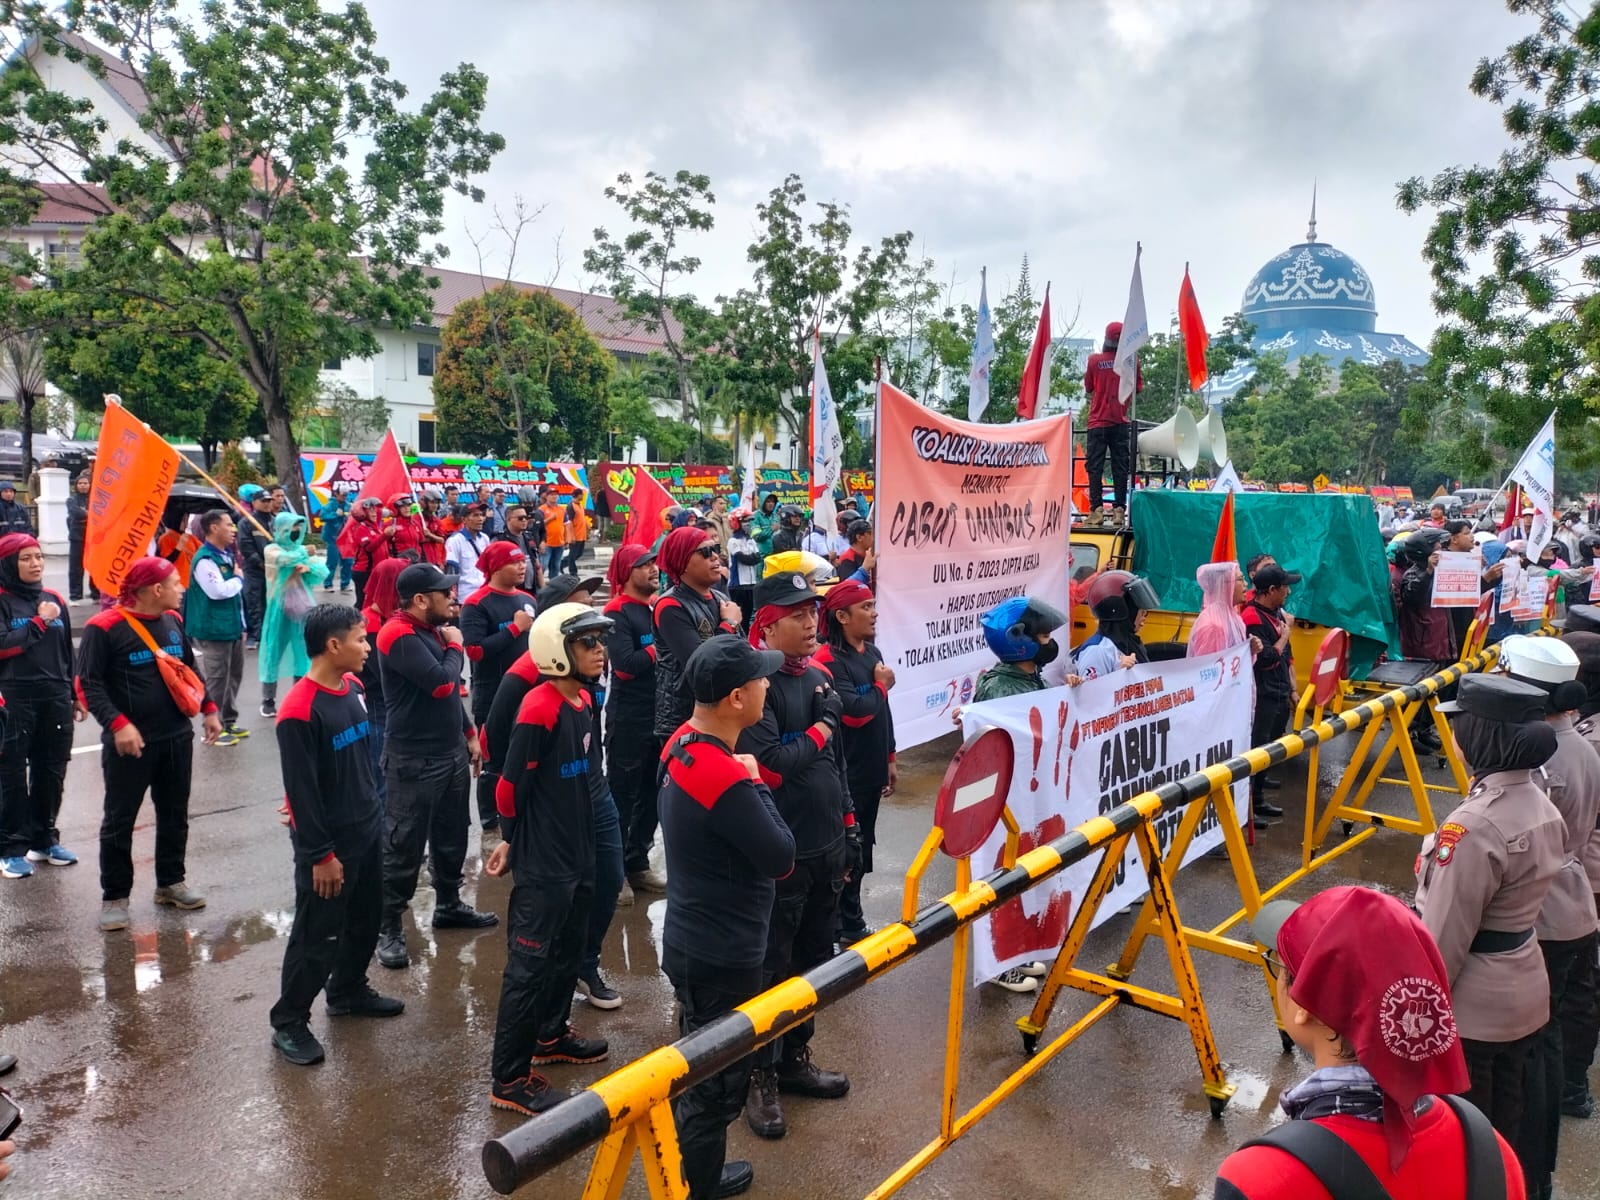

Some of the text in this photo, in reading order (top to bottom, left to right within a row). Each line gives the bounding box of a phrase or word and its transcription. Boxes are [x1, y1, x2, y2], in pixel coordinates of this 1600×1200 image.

[911, 426, 975, 464] KOALISI
[973, 439, 1021, 468] RAKYAT
[462, 465, 540, 484] Sukses
[961, 474, 1010, 494] MENUNTUT
[890, 495, 1065, 549] CABUT OMNIBUS LAW
[933, 553, 1040, 583] UU No. 6 /2023 CIPTA KERJA
[946, 596, 975, 614] HAPUS
[926, 618, 951, 640] TOLAK
[953, 616, 974, 634] UPAH
[905, 645, 935, 668] TOLAK
[937, 636, 974, 661] KENAIKAN
[1123, 682, 1145, 702] SPEE
[1081, 721, 1091, 743] PT
[1098, 717, 1170, 793] CABUT
[1381, 980, 1403, 1008] SERIKAT
[1403, 977, 1442, 994] PEKERJA
